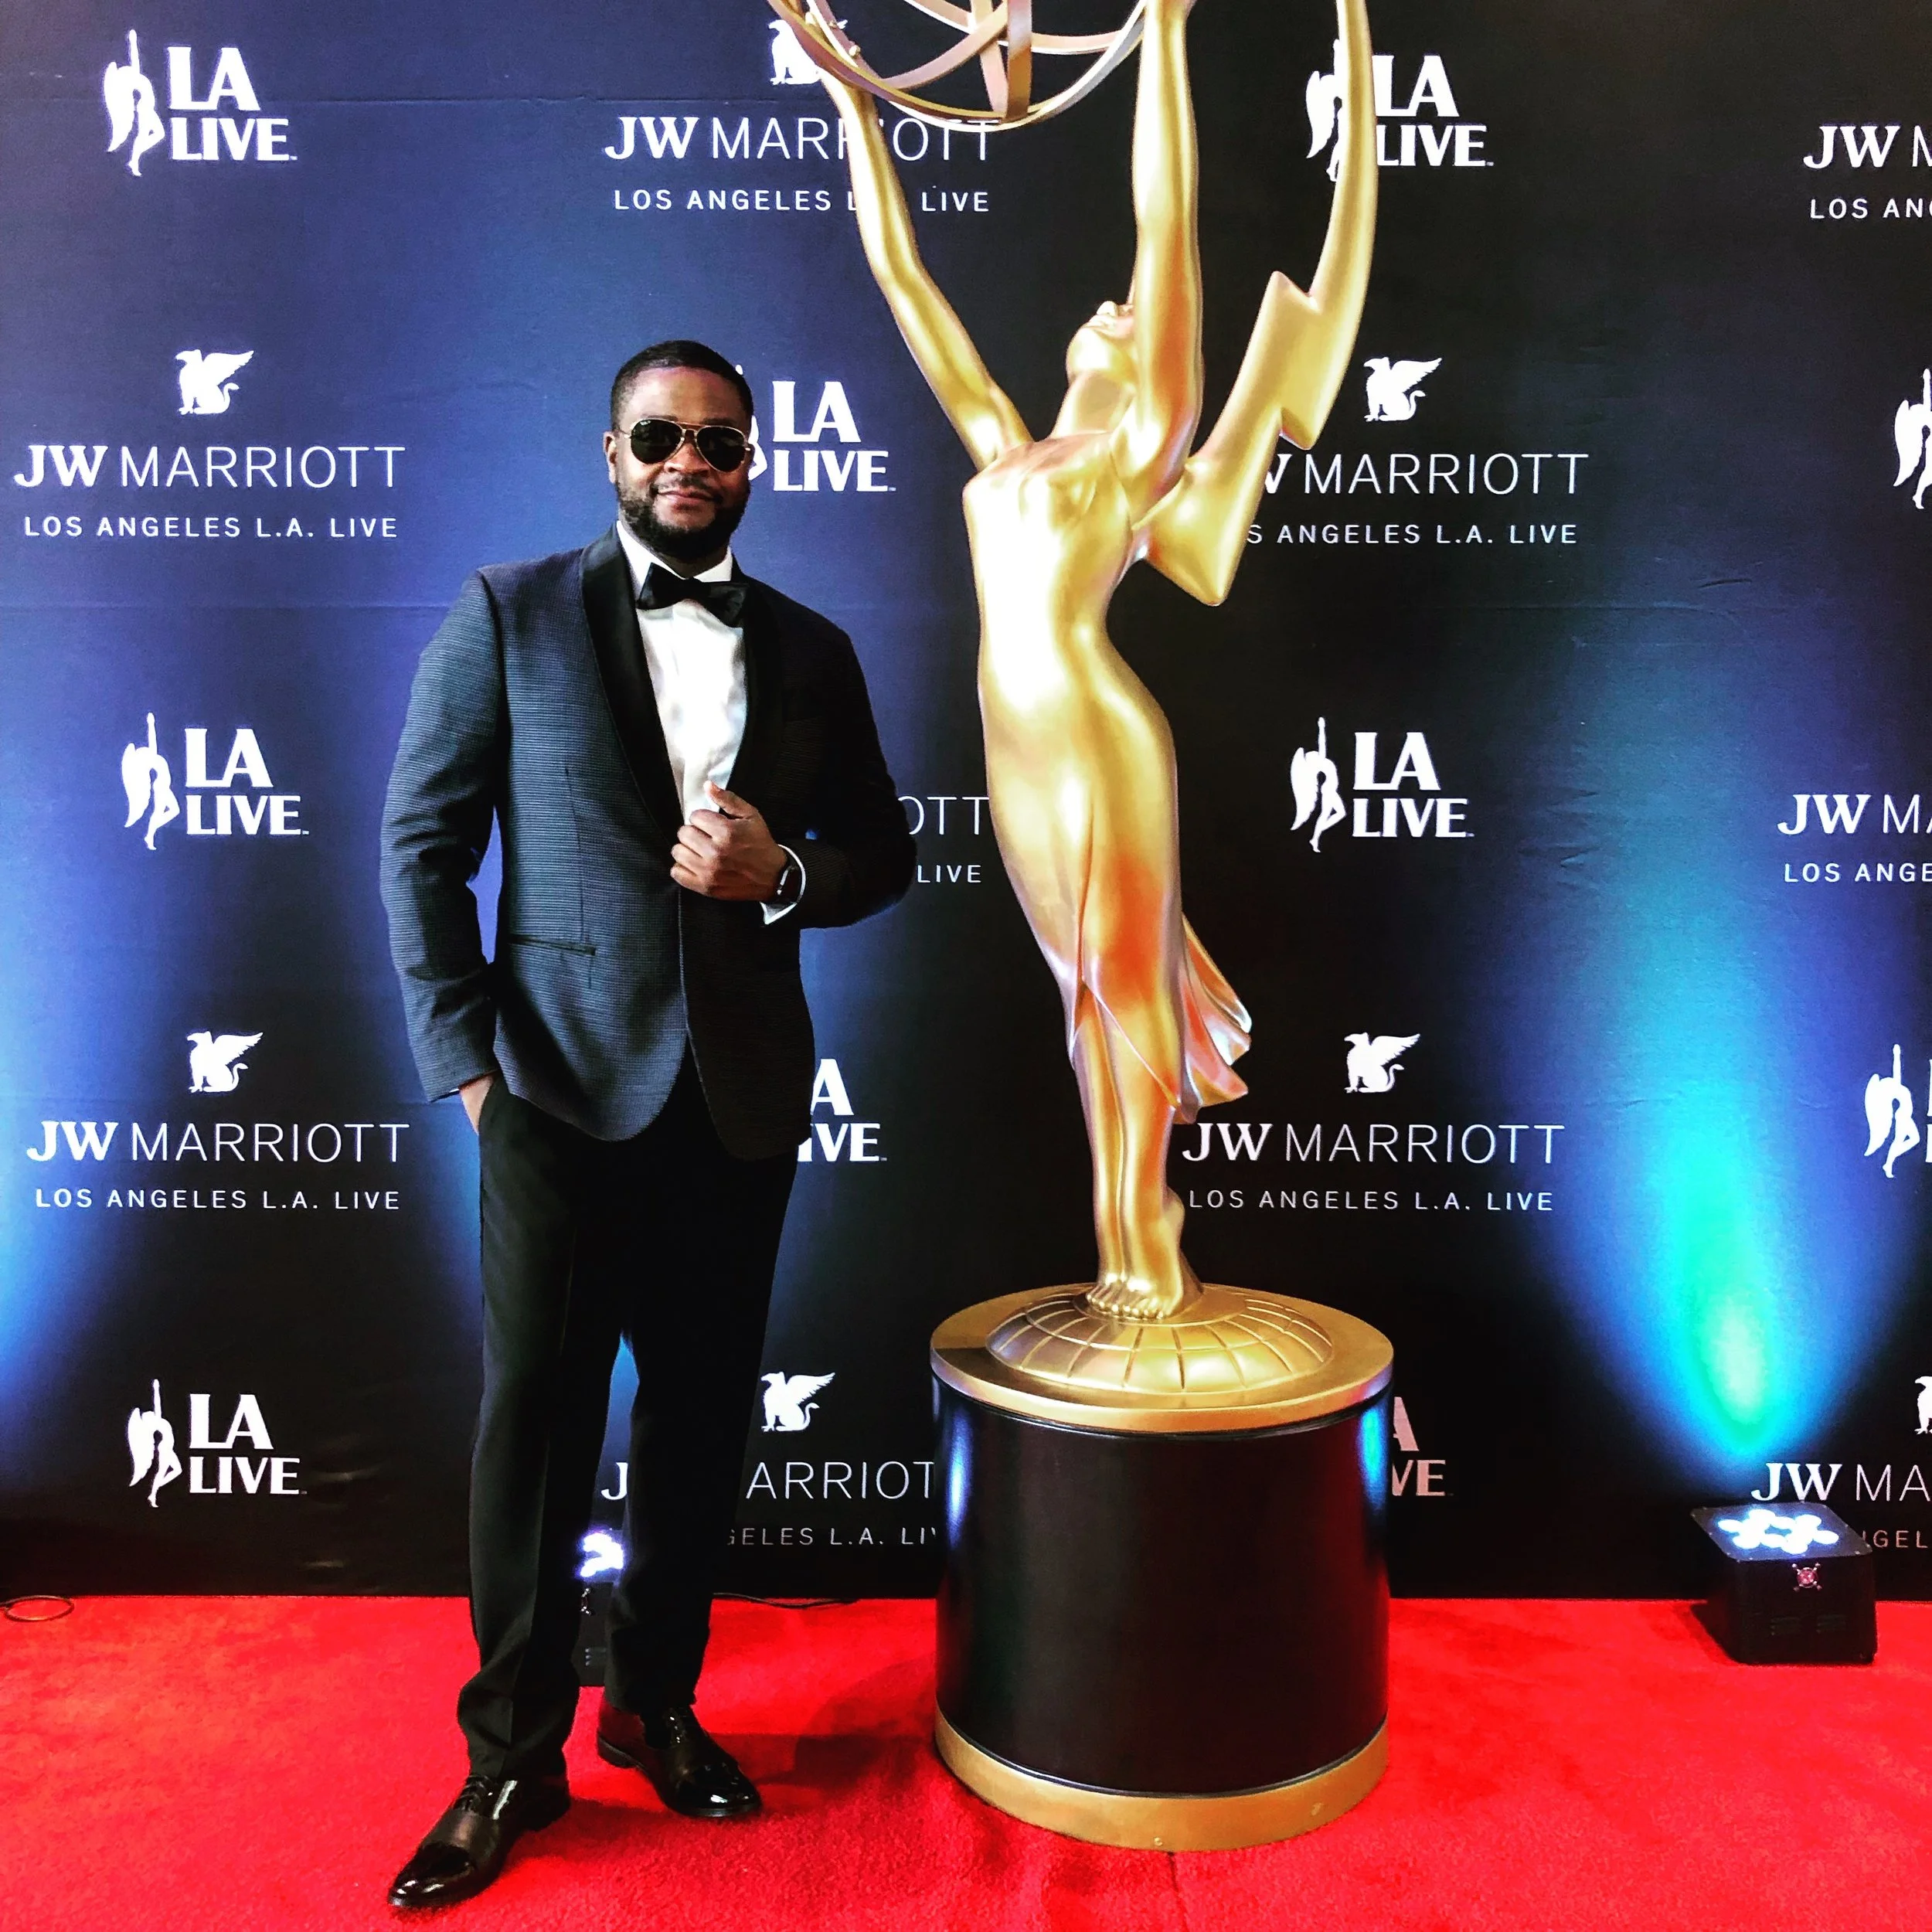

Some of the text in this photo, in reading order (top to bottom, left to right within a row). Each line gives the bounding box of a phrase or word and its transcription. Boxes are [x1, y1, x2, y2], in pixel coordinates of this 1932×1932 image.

[167, 46, 261, 111] LA
[1372, 55, 1460, 117] LA
[171, 117, 290, 161] LIVE
[604, 116, 999, 162] JW MAROTT
[1376, 125, 1487, 167] LIVE
[1803, 125, 1900, 169] JW
[614, 189, 672, 210] LOS
[686, 189, 831, 211] ANGELES
[921, 192, 989, 212] LIVE
[1810, 198, 1868, 219] LOS
[772, 380, 862, 443] LA
[13, 444, 406, 488] JW MARRIOTT
[773, 449, 889, 492] LIVE
[1304, 453, 1589, 495] MARRIOTT
[25, 515, 397, 538] LOS ANGELES L.A. LIVE
[1277, 524, 1420, 544] ANGELES
[1437, 525, 1493, 544] L.A.
[1510, 524, 1577, 544] LIVE
[184, 728, 274, 787] LA
[1352, 732, 1441, 791] LA
[185, 794, 301, 835] LIVE
[1352, 798, 1468, 838] LIVE
[1777, 794, 1871, 835] JW
[917, 865, 981, 883] LIVE
[1784, 862, 1932, 883] LOS ANGE
[810, 1058, 854, 1116] A
[26, 1121, 410, 1163] JW MARRIOTT
[797, 1122, 880, 1162] IVE
[1182, 1123, 1565, 1164] JW MARRIOTT
[36, 1188, 399, 1209] LOS ANGELES L.A. LIVE
[1189, 1189, 1553, 1211] LOS ANGELES L.A. LIVE
[189, 1393, 274, 1450] LA
[1393, 1396, 1420, 1451] A
[189, 1456, 301, 1495] LIVE
[601, 1461, 934, 1501] J ARRIOT
[1392, 1459, 1446, 1496] VE
[1750, 1462, 1843, 1502] JW
[727, 1527, 936, 1546] ELES L.A. LI
